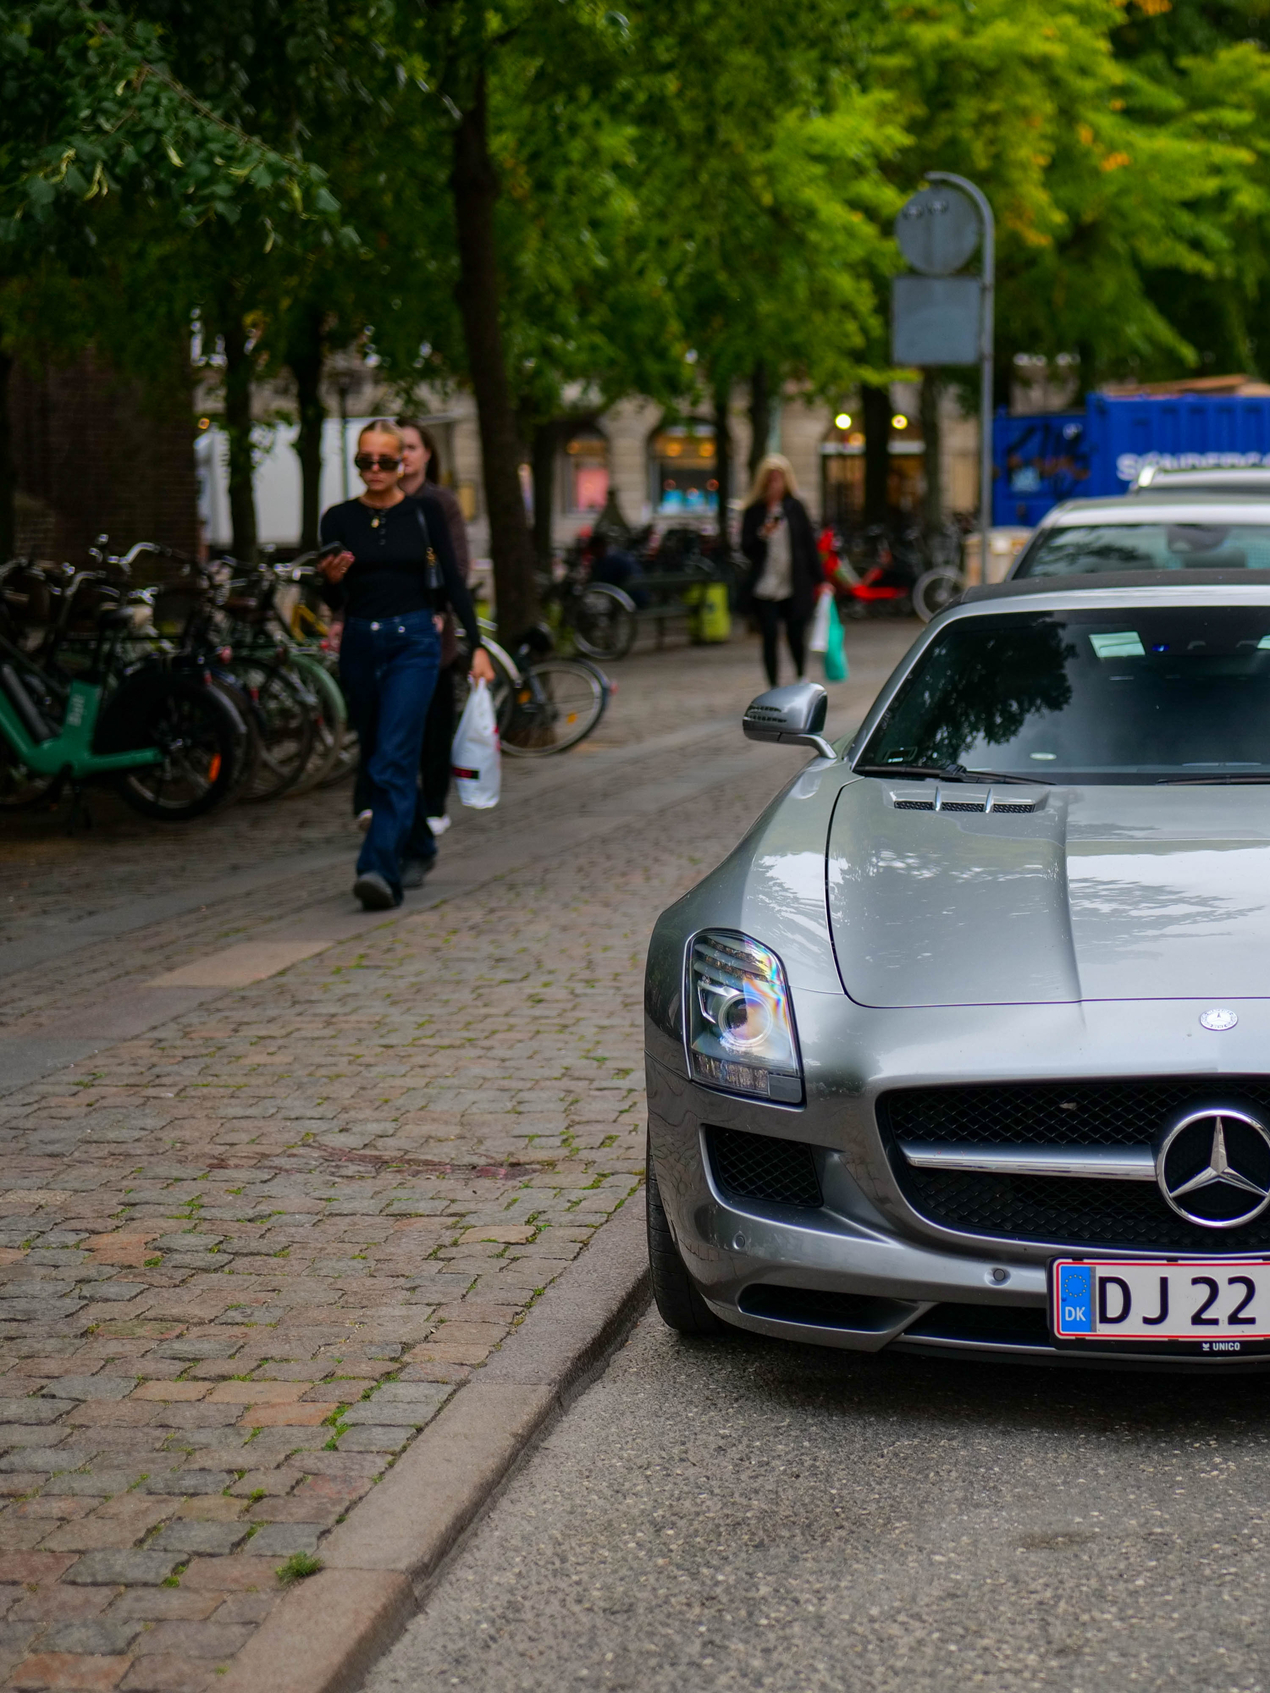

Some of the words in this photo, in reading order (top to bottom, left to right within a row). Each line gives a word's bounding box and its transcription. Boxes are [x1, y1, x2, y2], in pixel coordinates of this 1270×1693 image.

[1098, 1276, 1170, 1324] DJ
[1190, 1275, 1256, 1326] 22
[1065, 1306, 1086, 1321] DK
[1212, 1342, 1241, 1351] UNICO
